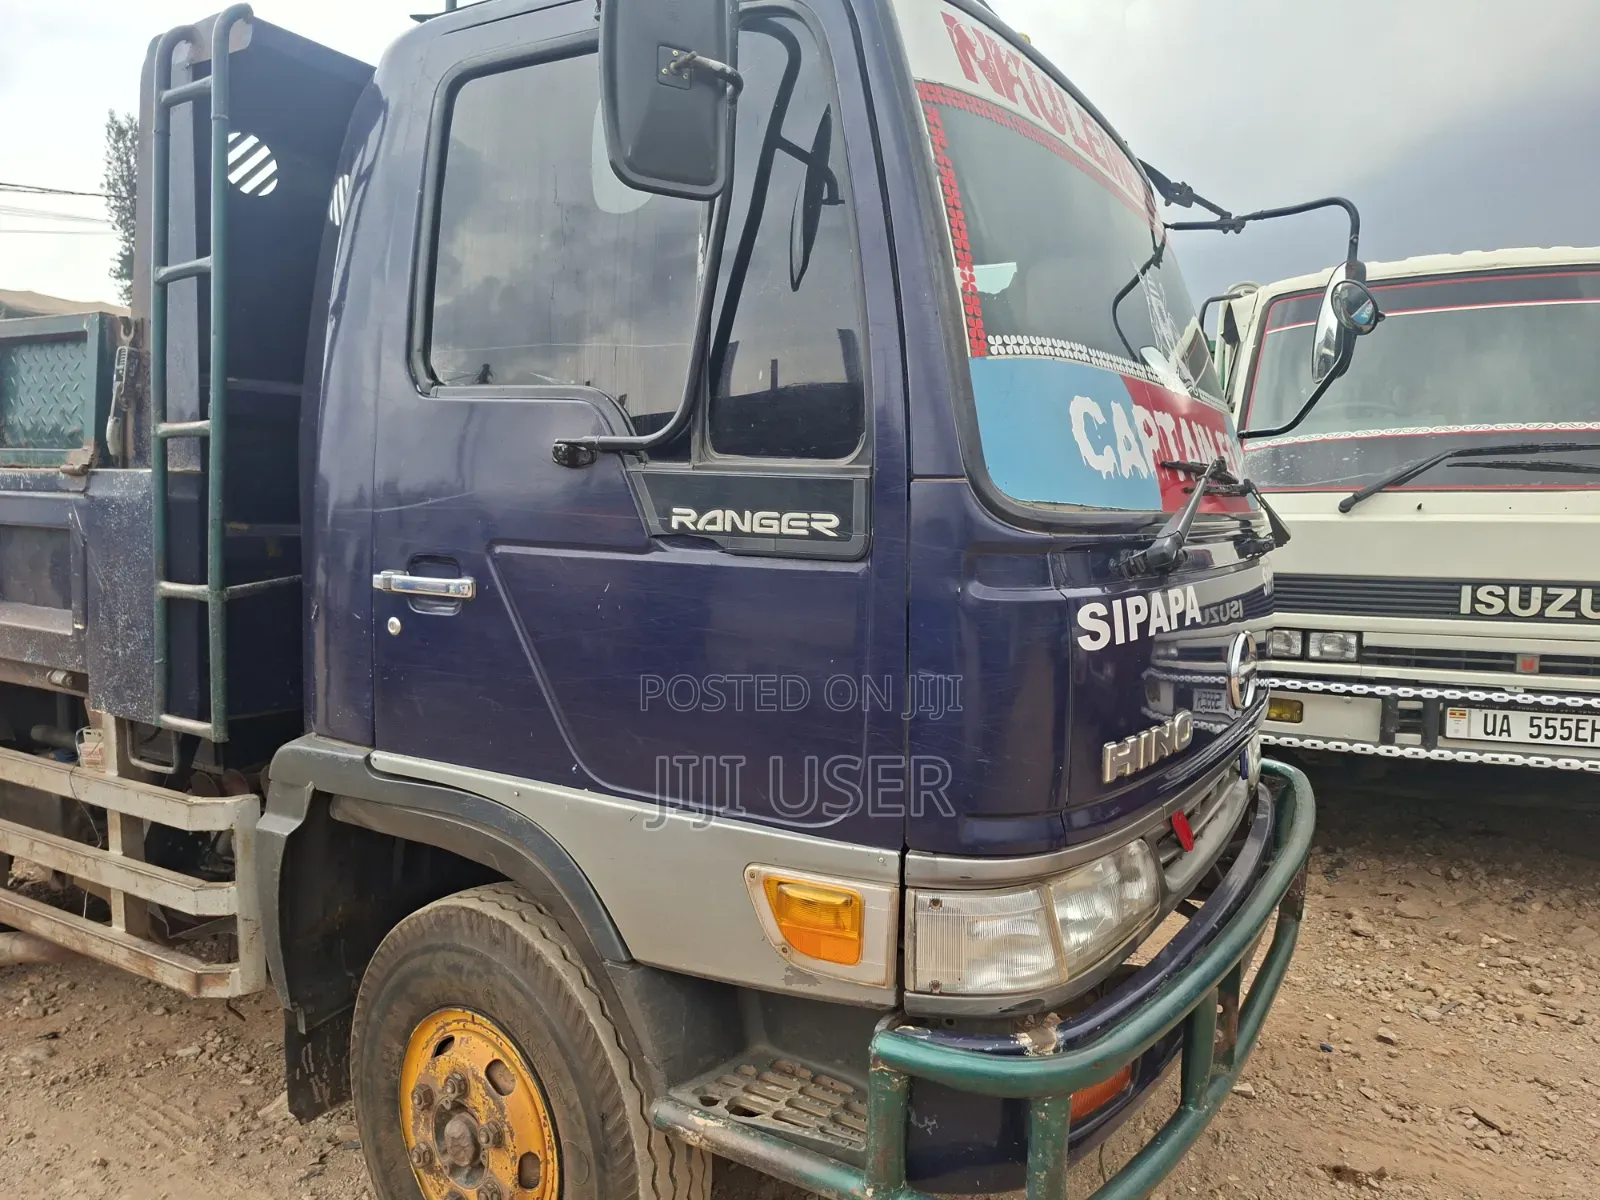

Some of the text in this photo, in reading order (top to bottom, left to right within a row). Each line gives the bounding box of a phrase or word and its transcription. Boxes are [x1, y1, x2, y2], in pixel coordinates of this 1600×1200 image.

[671, 507, 840, 537] RANGER
[1077, 586, 1201, 651] SIPAPA
[1102, 709, 1193, 784] HINO
[1483, 713, 1512, 737] UA
